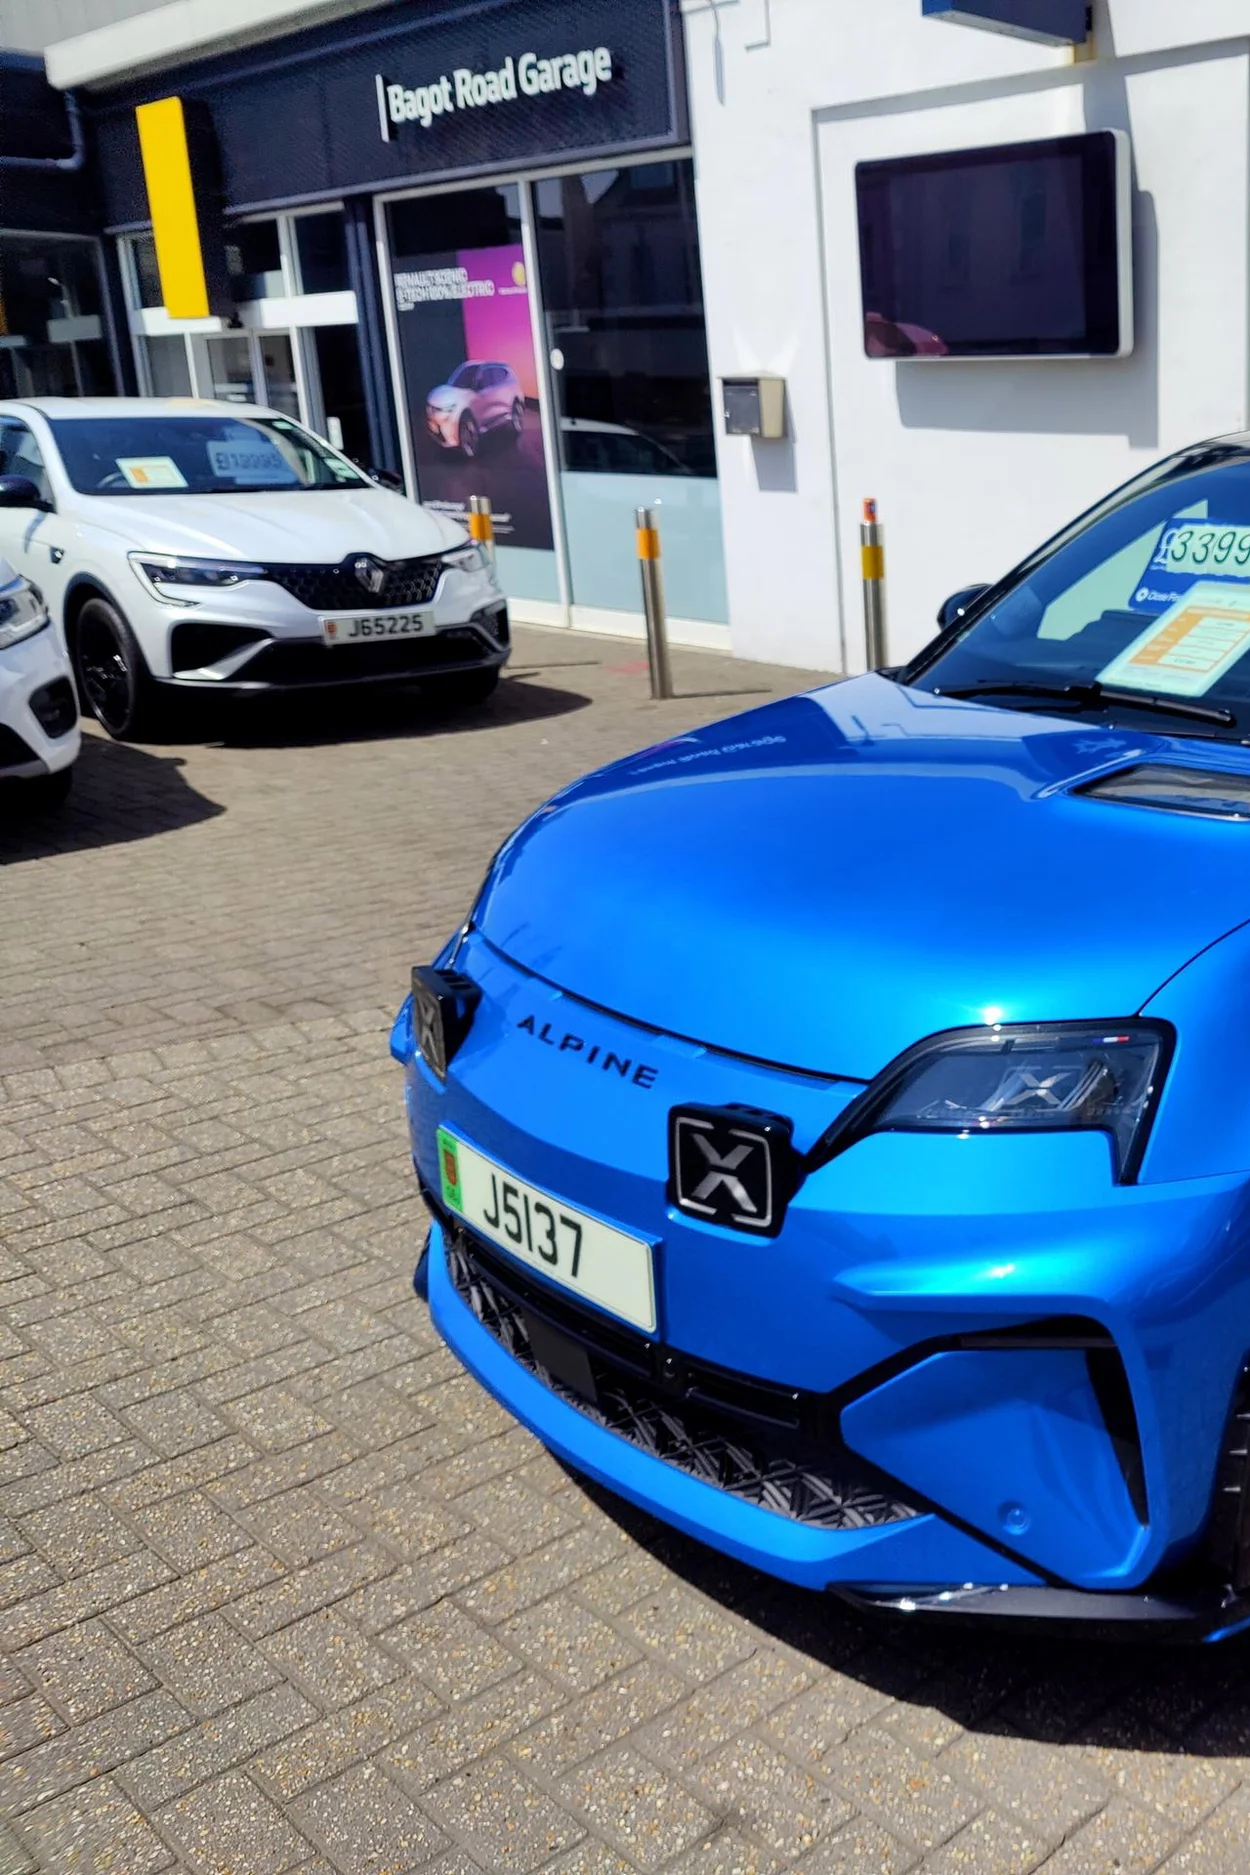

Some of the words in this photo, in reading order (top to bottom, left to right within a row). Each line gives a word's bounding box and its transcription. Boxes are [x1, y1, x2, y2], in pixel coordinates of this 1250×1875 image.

[387, 76, 454, 128] Bagot
[453, 56, 518, 109] Road
[518, 47, 612, 96] Garage
[348, 614, 423, 637] J65225
[516, 1014, 659, 1090] ALPINE
[483, 1172, 583, 1279] J5137
